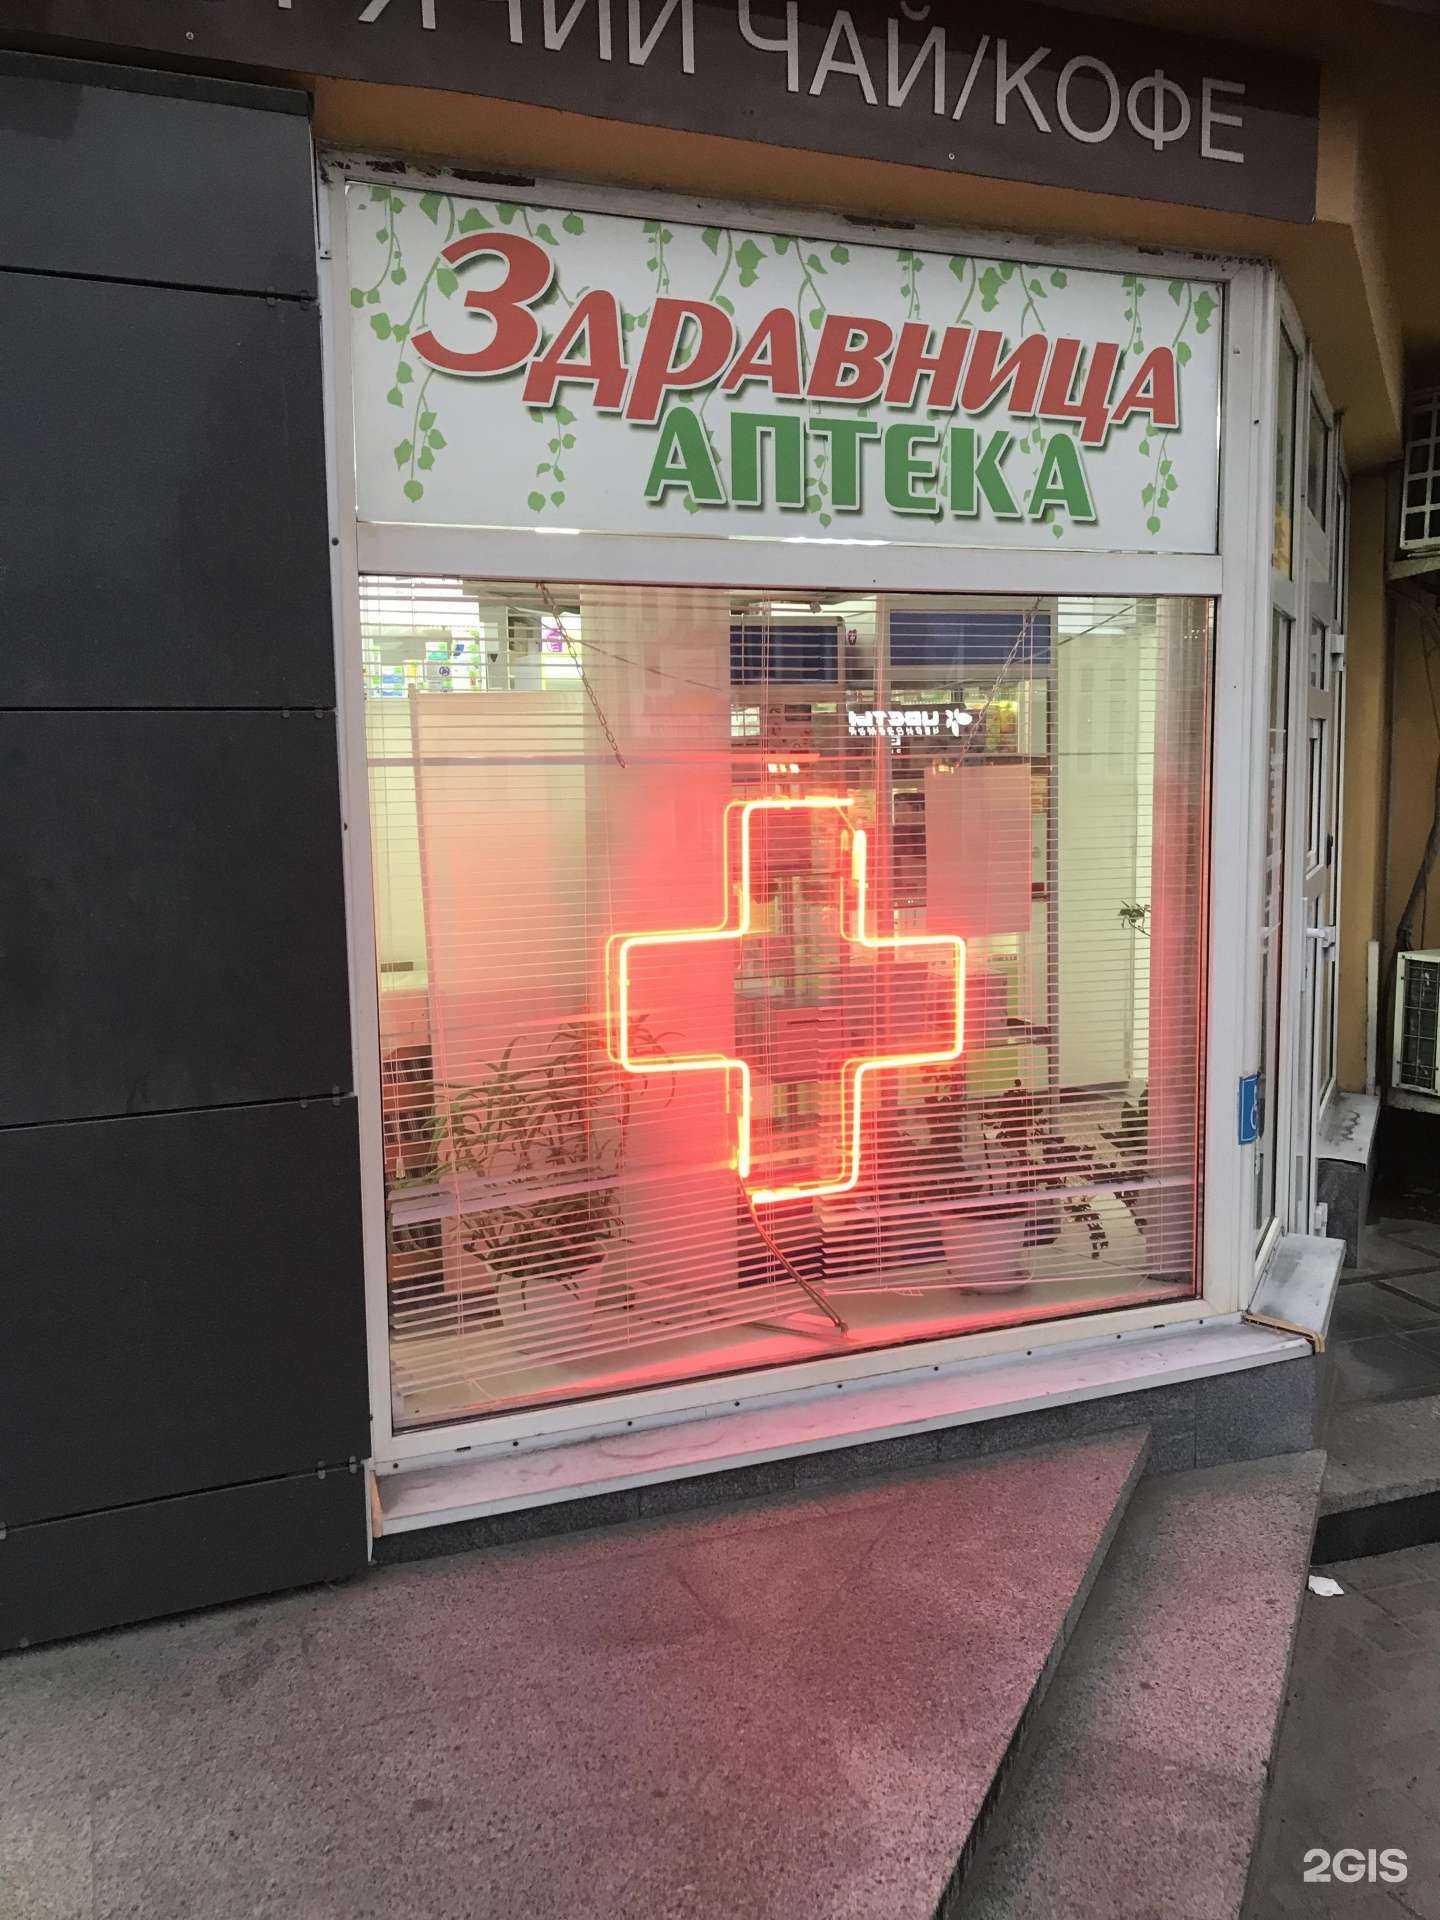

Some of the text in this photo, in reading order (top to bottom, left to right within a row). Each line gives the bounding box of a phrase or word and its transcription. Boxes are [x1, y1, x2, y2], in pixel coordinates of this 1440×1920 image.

[738, 0, 1246, 163] ЧАЙ/КОФЕ
[409, 231, 1181, 446] ЗДРАВНИЦА
[643, 406, 1098, 522] АПТЕКА
